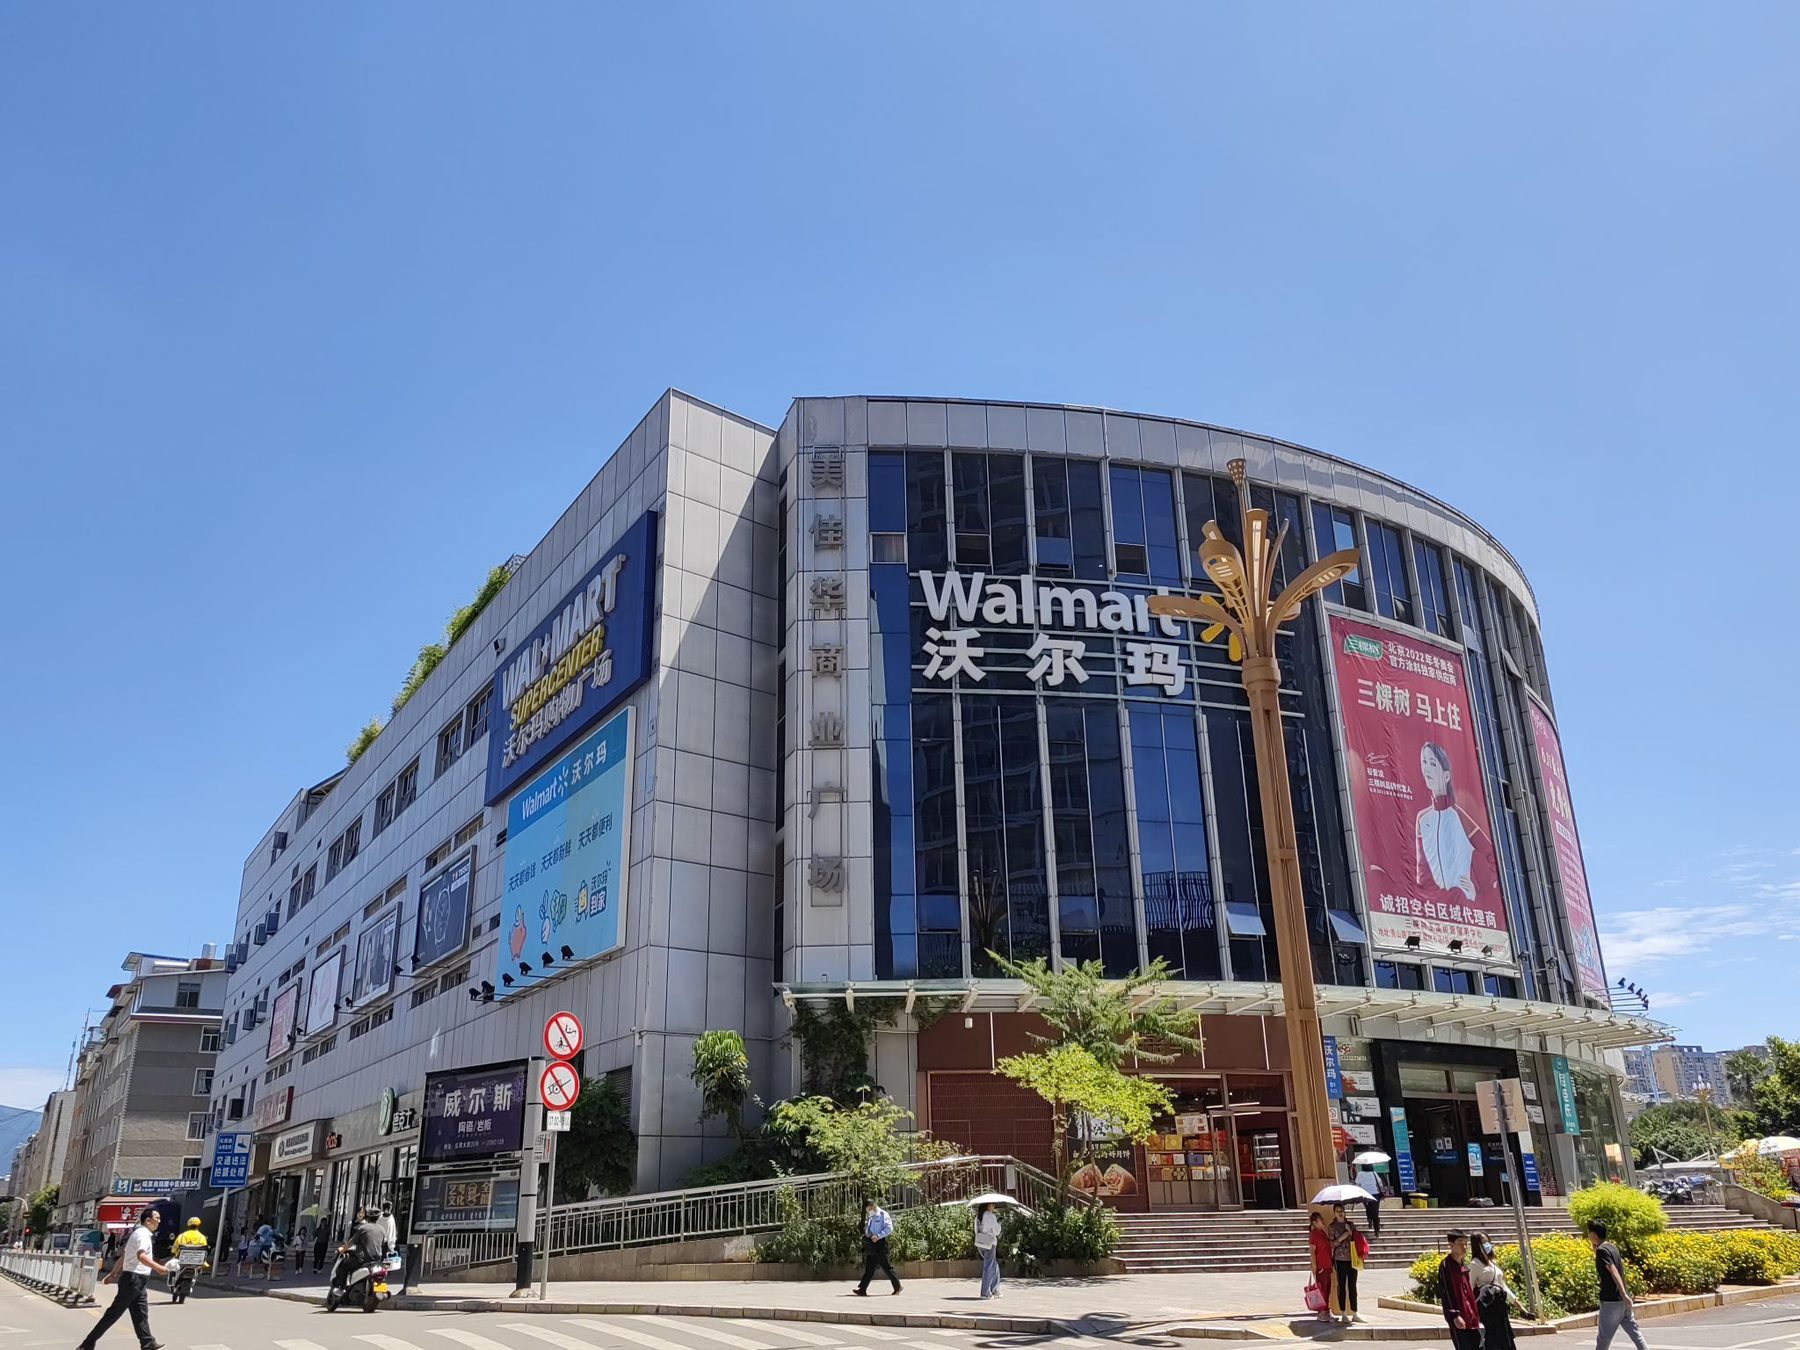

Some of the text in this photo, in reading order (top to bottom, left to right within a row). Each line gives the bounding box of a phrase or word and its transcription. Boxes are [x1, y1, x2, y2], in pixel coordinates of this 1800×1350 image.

[918, 569, 1182, 637] Walmart
[510, 623, 604, 731] SUPERCENTER
[807, 452, 846, 893] 美佳华商业广场
[921, 626, 1187, 697] 沃尔玛
[502, 649, 613, 768] 沃尔玛购物广场
[1357, 678, 1462, 731] 三棵树 马上住
[522, 739, 608, 821] Walmart 沃尔玛
[577, 811, 613, 851] 天天都便利
[590, 890, 607, 917] 到家
[1380, 893, 1497, 929] 诚招空白区域代理商
[393, 1111, 412, 1132] 德克士
[443, 1083, 513, 1118] 威尔斯
[213, 1167, 245, 1177] 拍摄处理
[216, 1155, 247, 1166] 交通违法
